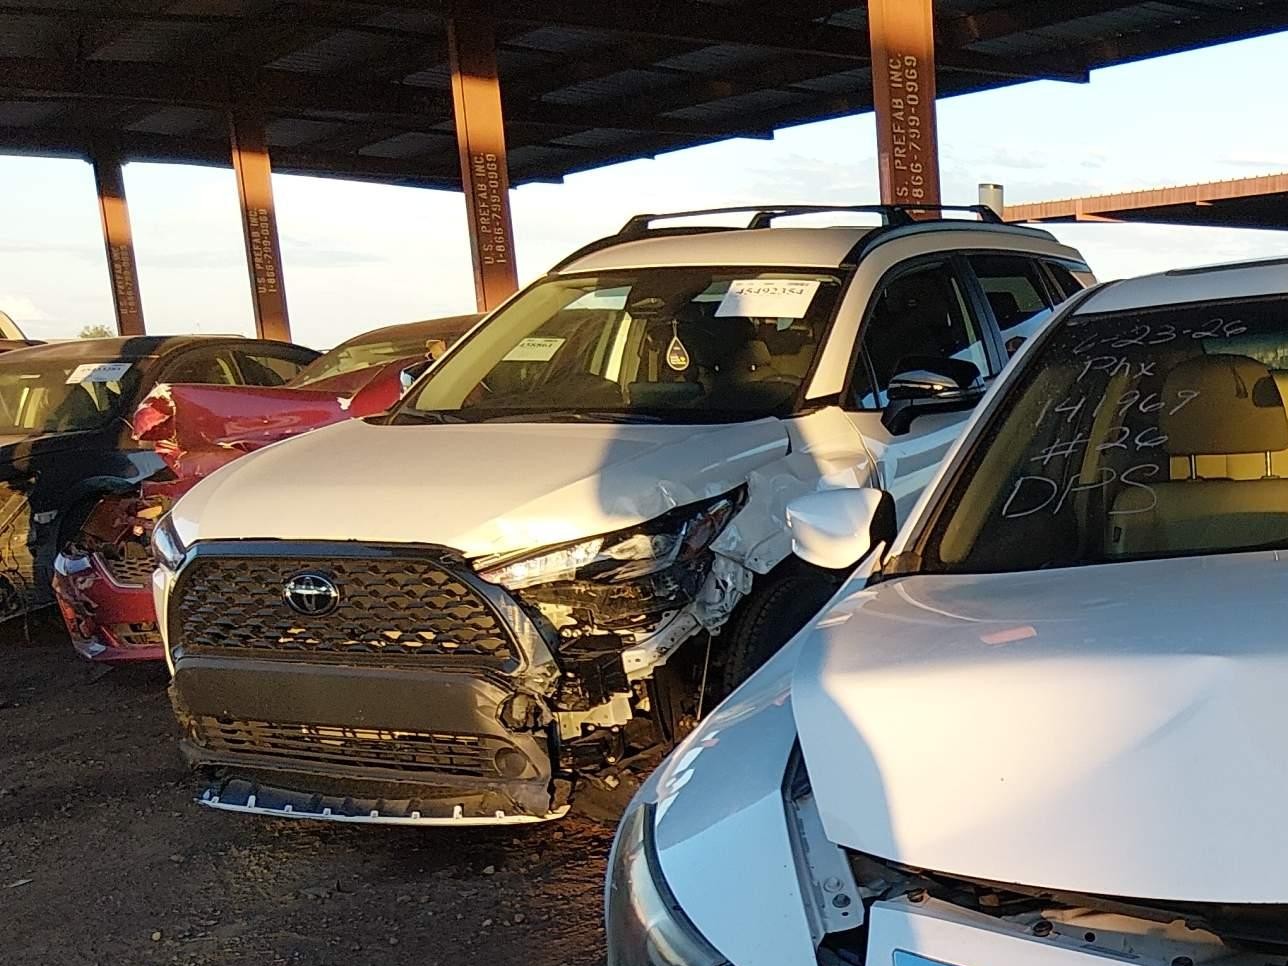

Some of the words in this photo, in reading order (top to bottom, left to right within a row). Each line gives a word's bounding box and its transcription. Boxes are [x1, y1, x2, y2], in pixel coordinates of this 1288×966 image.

[889, 53, 902, 88] INC.
[892, 98, 907, 170] PREFAB
[905, 55, 926, 214] 1-866-799-0969
[474, 152, 486, 177] INC.
[477, 183, 492, 233] PREFAB
[1002, 463, 1160, 519] DPS
